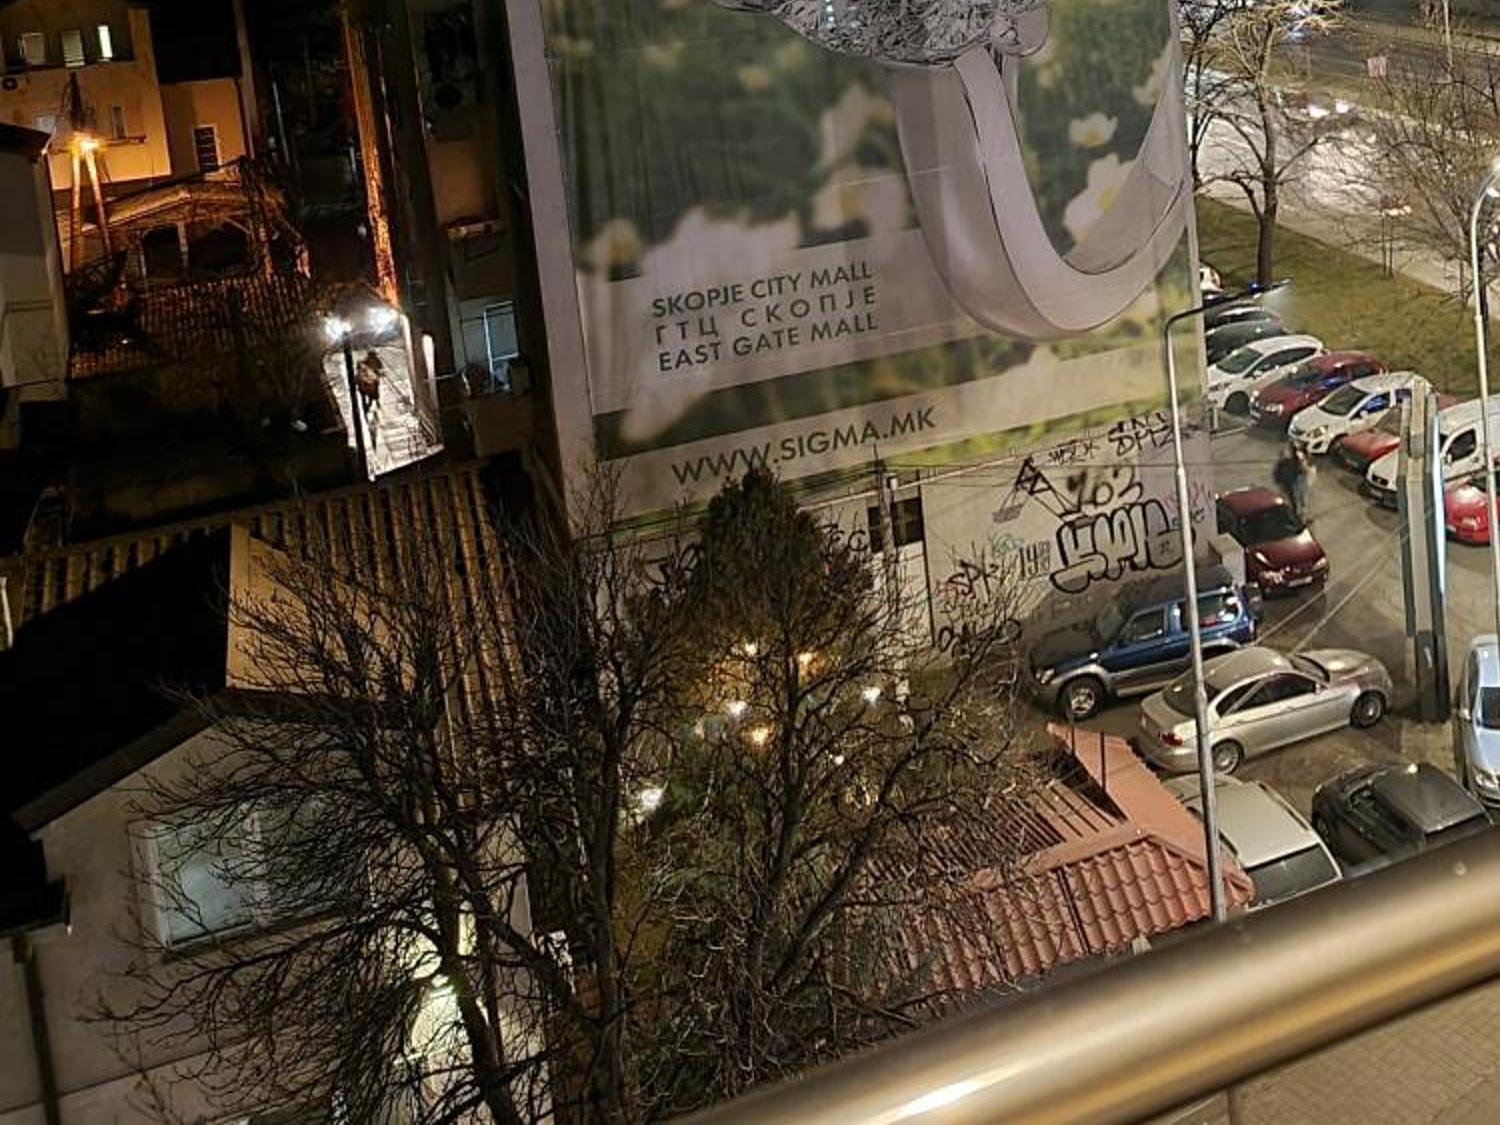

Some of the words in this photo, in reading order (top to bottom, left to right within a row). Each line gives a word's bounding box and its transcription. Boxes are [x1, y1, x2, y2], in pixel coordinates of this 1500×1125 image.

[652, 284, 744, 318] SKOPJE
[751, 272, 802, 299] CITY
[810, 261, 873, 289] MALL
[655, 316, 720, 346] ГТЦ
[741, 285, 876, 328] СКОПЈЕ
[659, 342, 721, 372] EAST
[733, 327, 801, 356] GATE
[810, 313, 878, 343] MALL
[671, 406, 936, 485] WWW.SIGMA.MK
